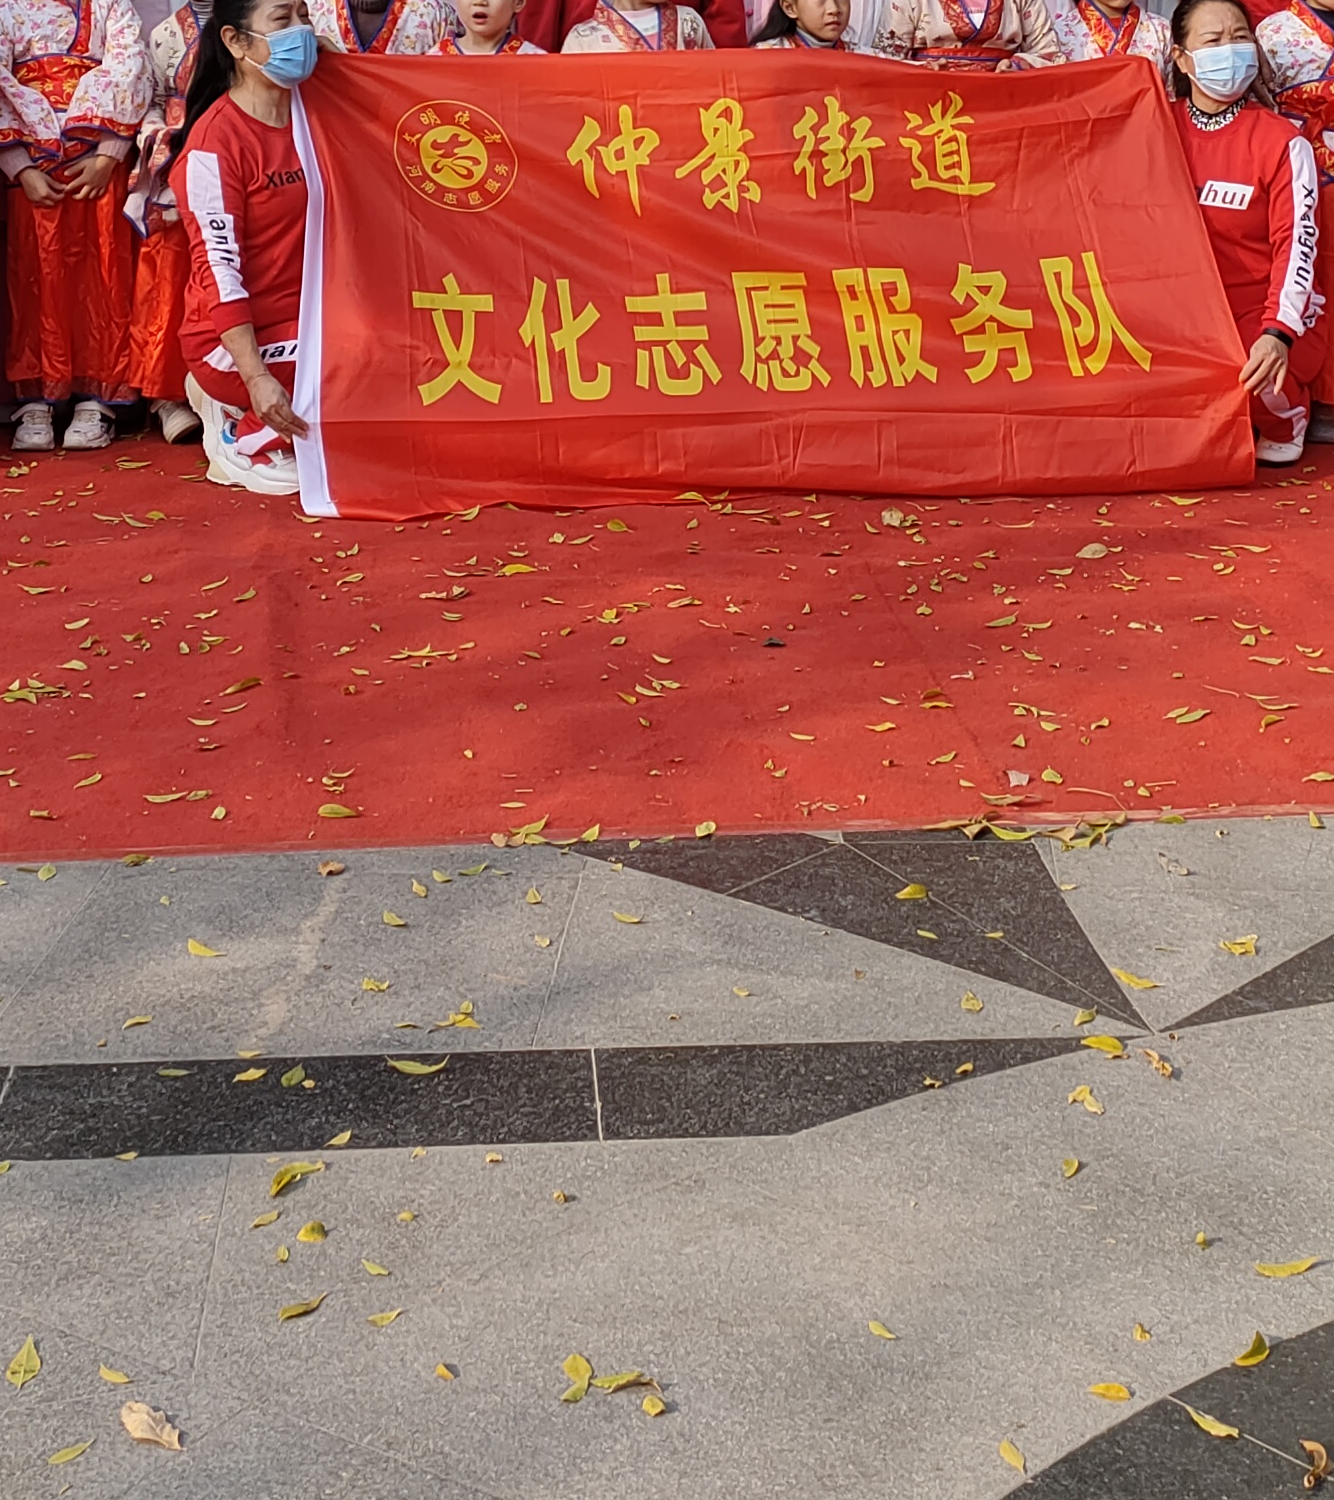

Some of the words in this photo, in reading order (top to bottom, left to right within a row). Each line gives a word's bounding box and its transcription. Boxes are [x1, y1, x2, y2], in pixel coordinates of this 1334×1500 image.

[567, 90, 995, 215] 仲景街道
[411, 251, 1152, 405] 文化志愿服务队
